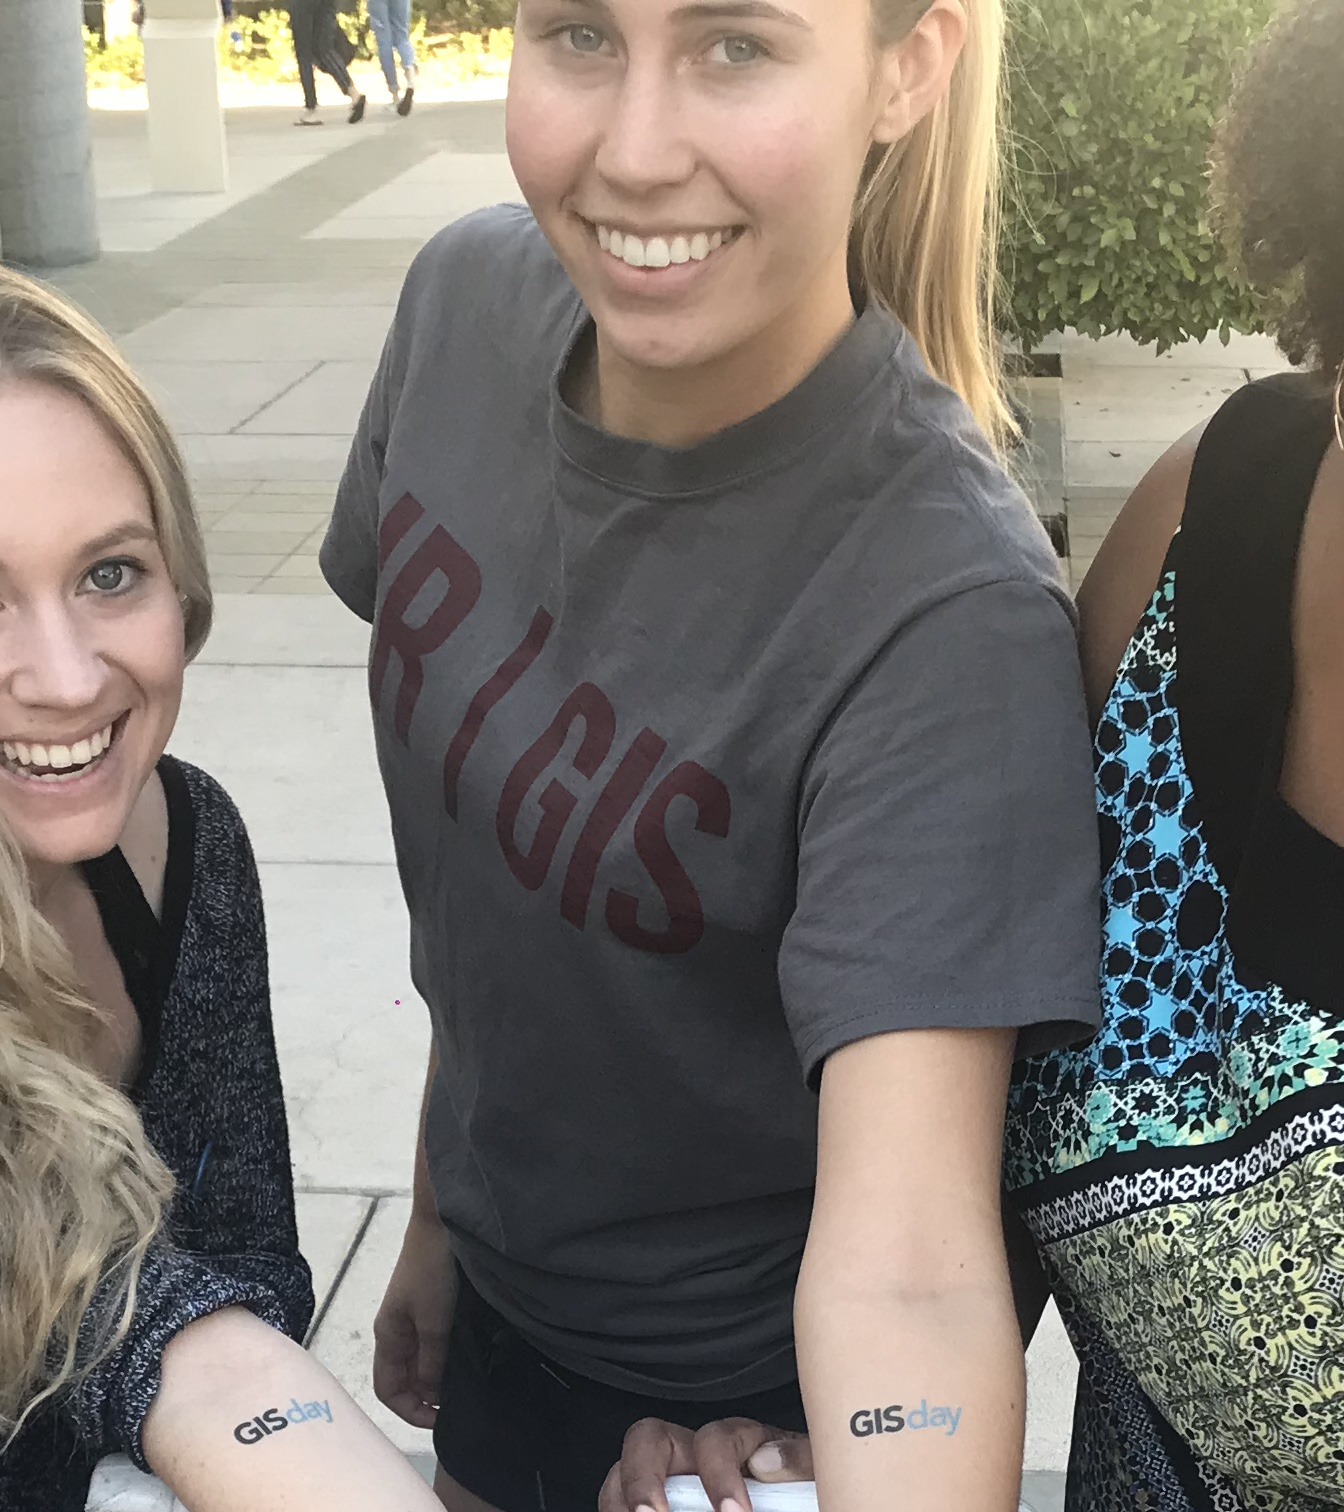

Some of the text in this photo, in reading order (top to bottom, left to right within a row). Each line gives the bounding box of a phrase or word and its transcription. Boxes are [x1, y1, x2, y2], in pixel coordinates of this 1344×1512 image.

[496, 681, 731, 954] GIS
[234, 1398, 333, 1445] GISday
[850, 1399, 962, 1437] GISday
